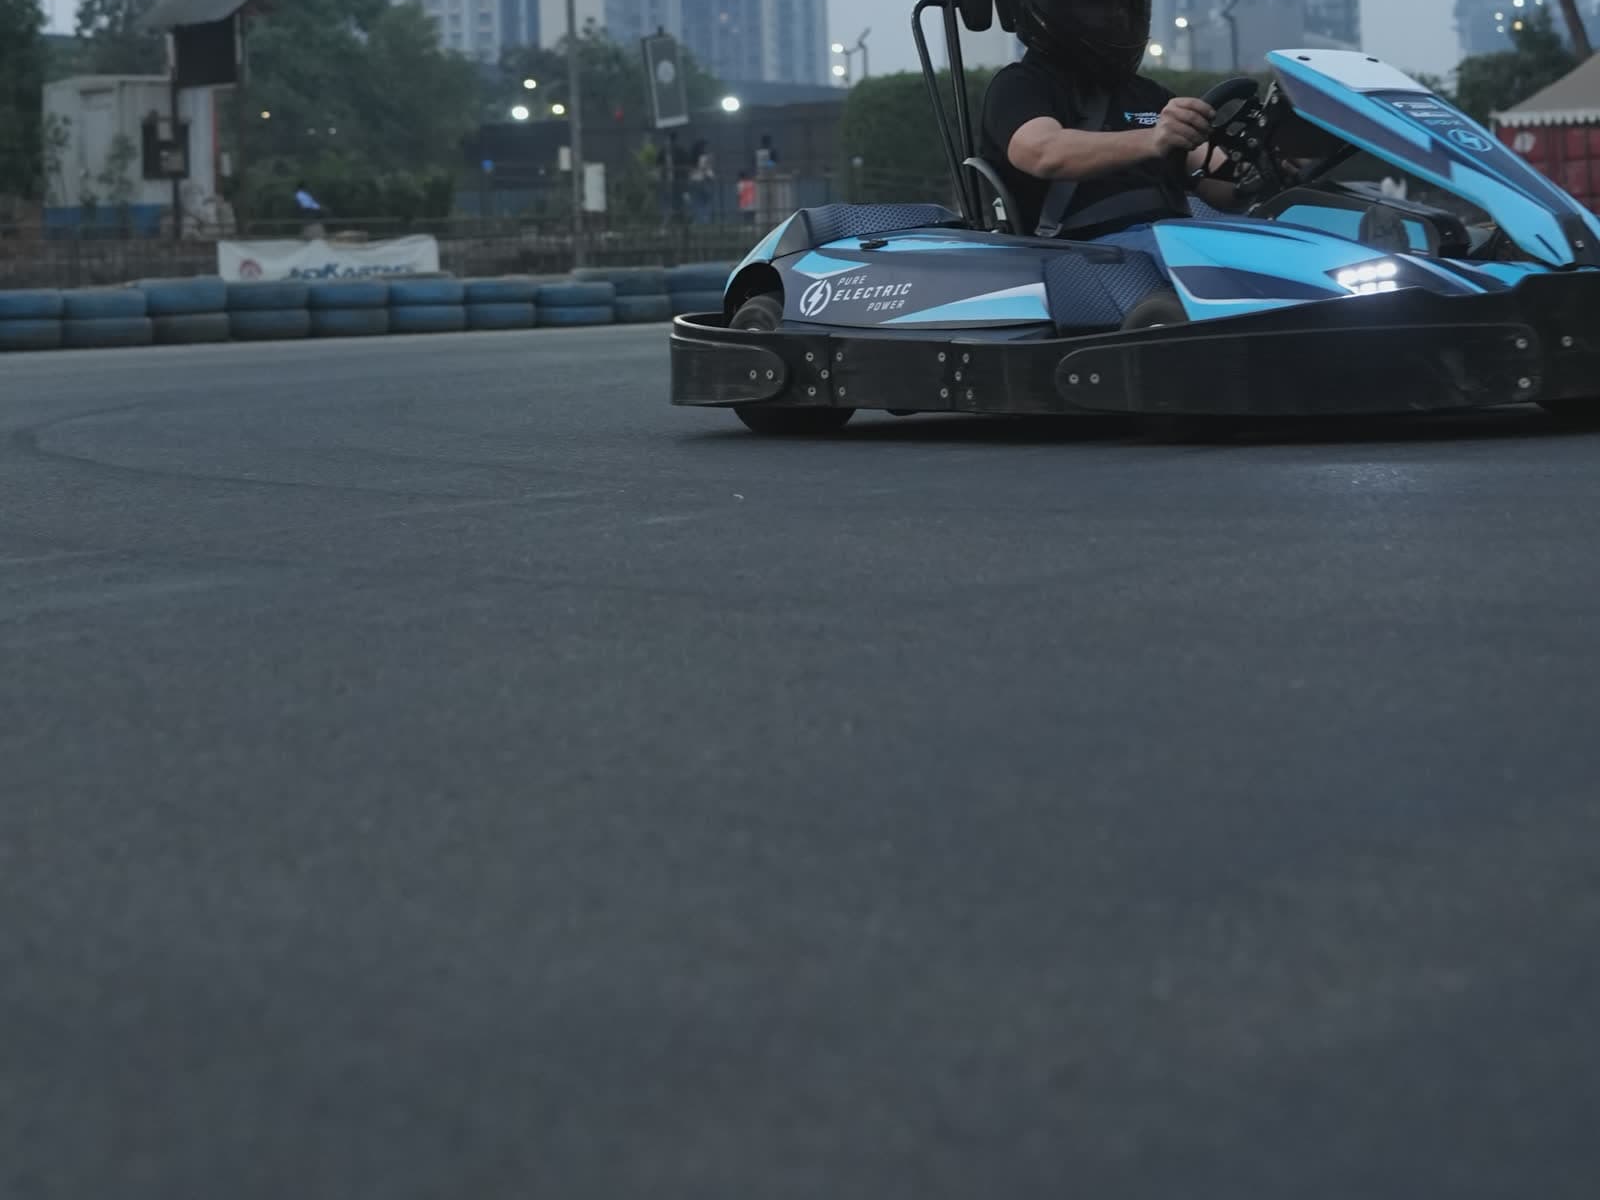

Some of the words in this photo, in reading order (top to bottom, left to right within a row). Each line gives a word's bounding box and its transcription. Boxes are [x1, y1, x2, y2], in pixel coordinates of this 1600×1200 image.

[837, 275, 867, 286] PURE
[832, 283, 912, 301] ELECTRIC
[866, 300, 905, 312] POWER
